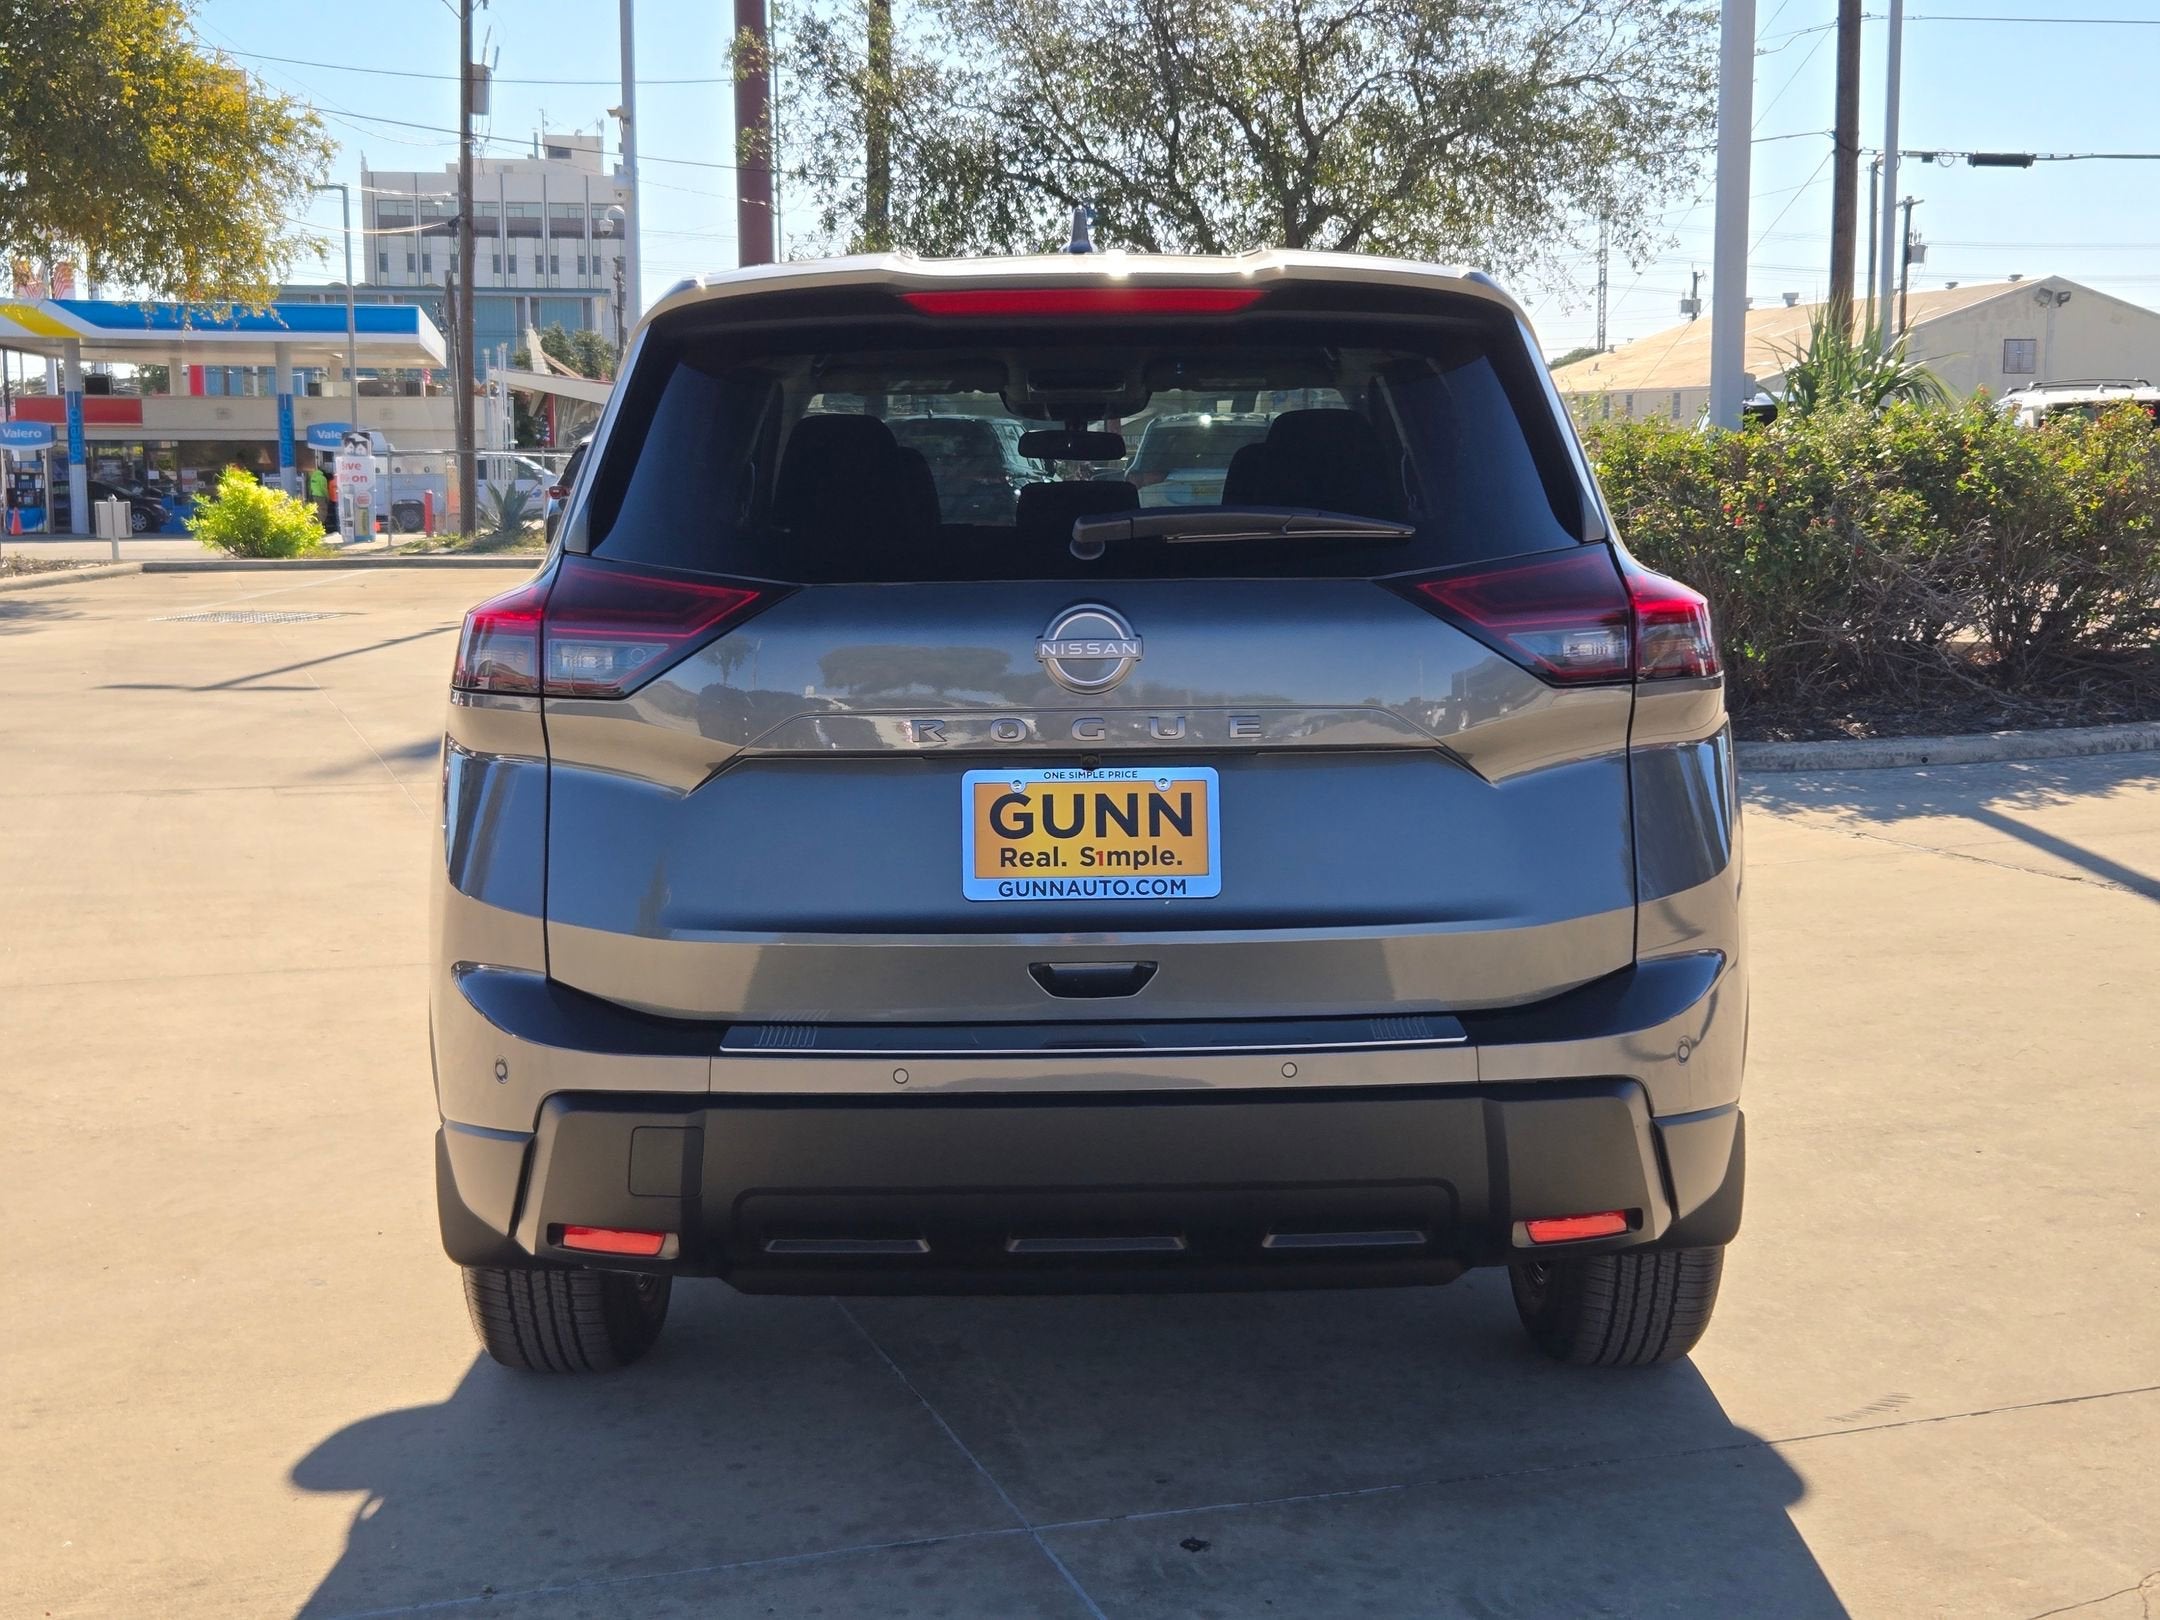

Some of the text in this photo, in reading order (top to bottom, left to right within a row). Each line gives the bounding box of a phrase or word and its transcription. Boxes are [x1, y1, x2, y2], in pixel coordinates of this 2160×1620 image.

[2, 428, 42, 439] Valero
[316, 430, 342, 440] Vale
[1041, 643, 1137, 656] NISSAN
[910, 715, 1263, 743] ROGUE
[1043, 770, 1138, 780] ONE SIMPLE PRICE
[989, 792, 1193, 840] GUNN
[1000, 846, 1067, 867] Real.
[998, 879, 1187, 898] GUNNAUTO.COM
